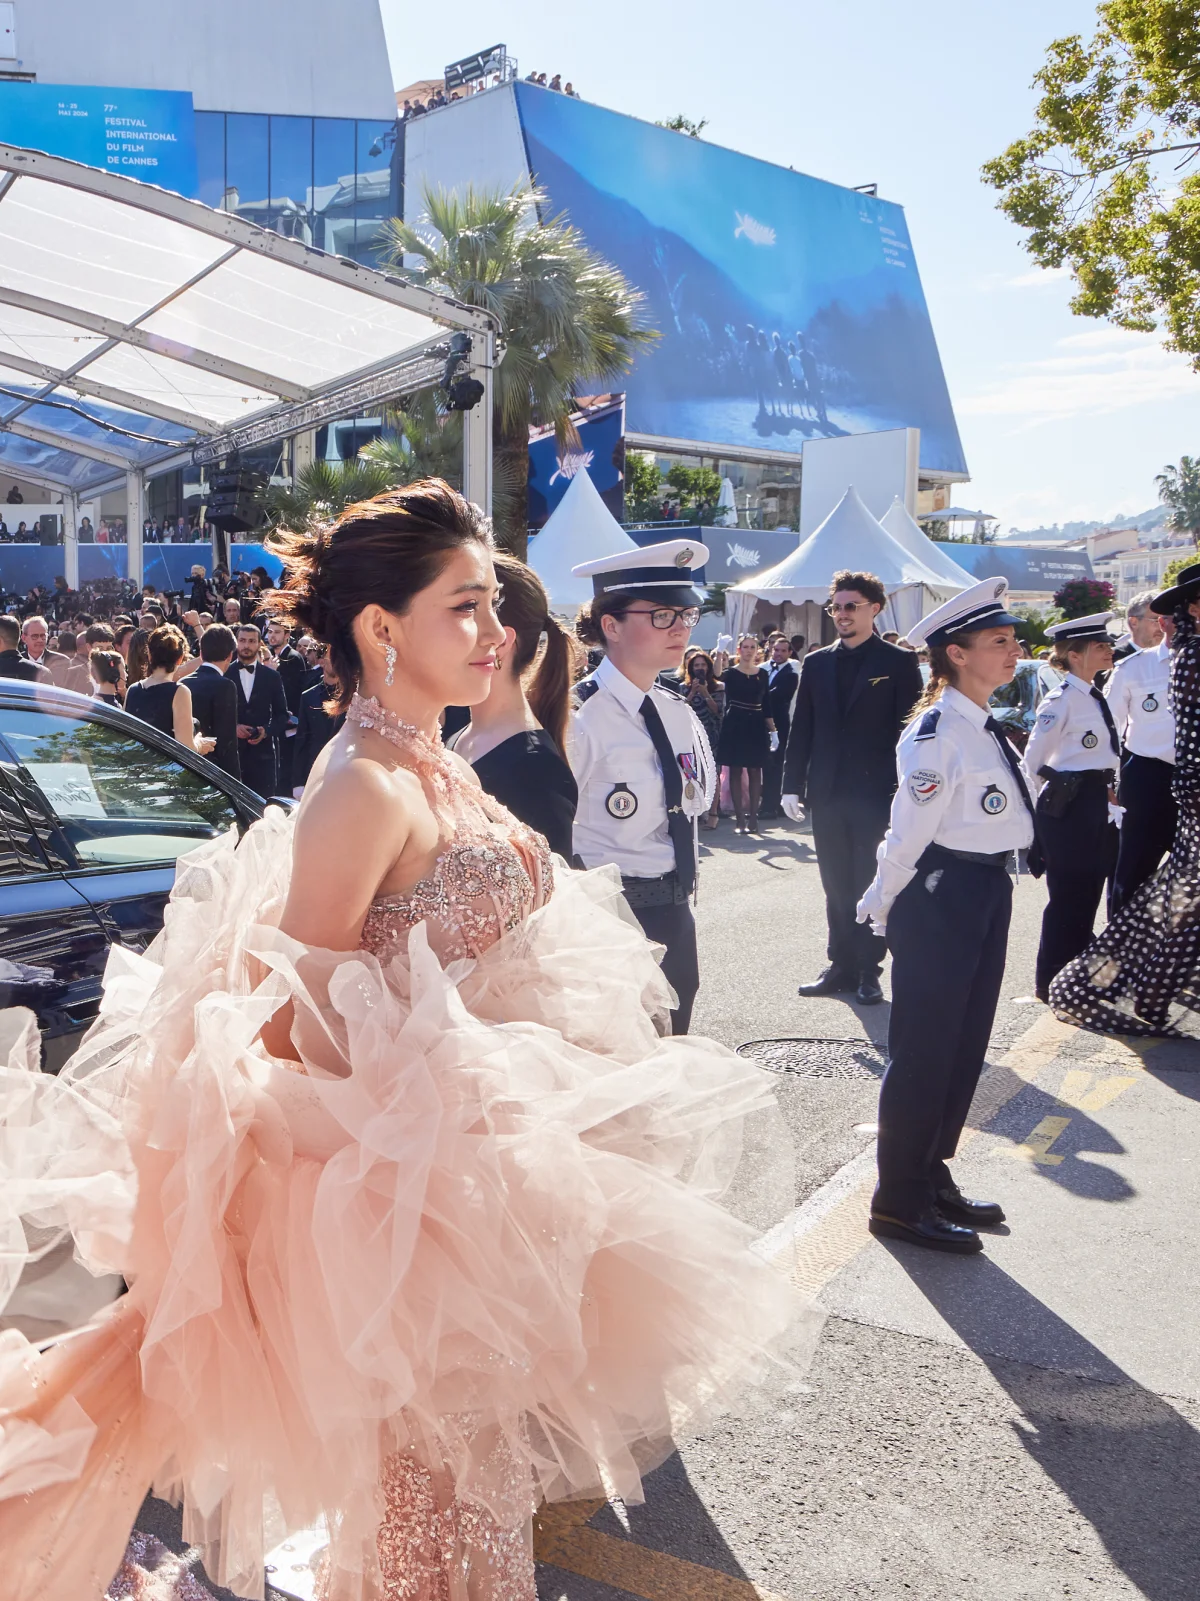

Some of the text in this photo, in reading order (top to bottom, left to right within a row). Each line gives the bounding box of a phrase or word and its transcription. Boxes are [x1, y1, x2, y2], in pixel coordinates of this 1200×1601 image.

[104, 117, 147, 127] FESTIVAL
[105, 130, 177, 141] INTERNATIONAL
[106, 143, 144, 152] DU FILM
[107, 156, 158, 166] DE CANNES
